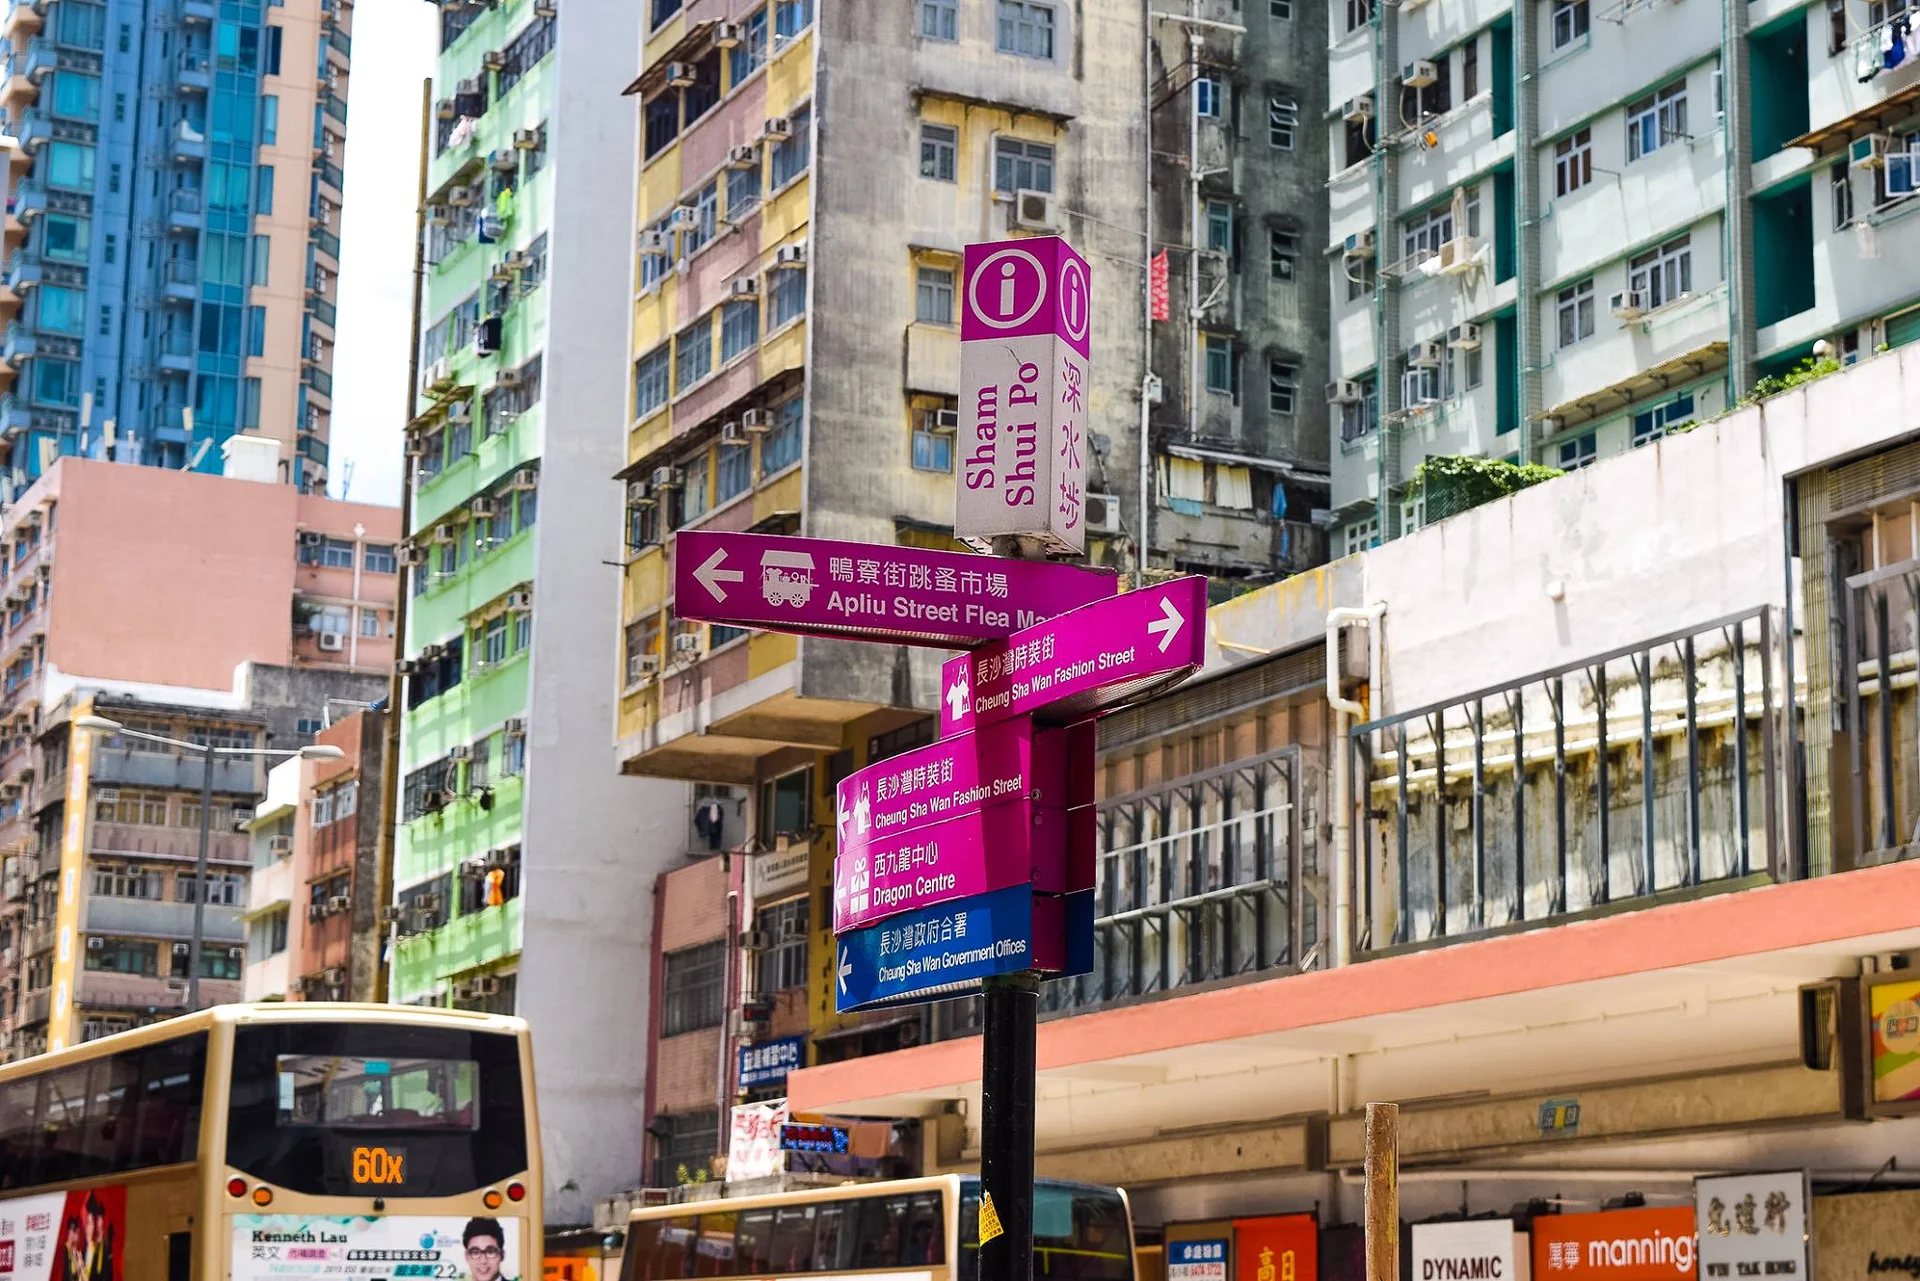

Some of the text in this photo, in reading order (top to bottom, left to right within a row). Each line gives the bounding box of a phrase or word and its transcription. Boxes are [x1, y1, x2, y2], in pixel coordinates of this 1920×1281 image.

[966, 384, 998, 490] Sham
[1005, 362, 1039, 508] Shui Po
[1059, 355, 1082, 530] 深水埗
[829, 556, 1009, 599] 鴨寮街跳蚤市場
[827, 590, 887, 618] Apliu
[893, 596, 958, 623] Street
[965, 604, 1010, 629] Flea
[975, 646, 1135, 714] Cheung Sha Wan Fashion Street
[976, 633, 1055, 687] 長沙灣時裝街
[875, 773, 1023, 829] Cheung Sha Wan Fashion Street
[876, 757, 954, 803] 長沙灣時裝街
[874, 840, 939, 879] 西九龍中心
[873, 872, 956, 907] Dragon Centre
[880, 911, 968, 957] 長沙灣政府合署
[878, 938, 1027, 983] Cheung Sha Wan Government Offices
[252, 1229, 348, 1244] Kenneth Lau
[252, 1245, 280, 1260] 英文
[1422, 1255, 1503, 1281] DYNAMIC
[1736, 1260, 1761, 1276] TAK
